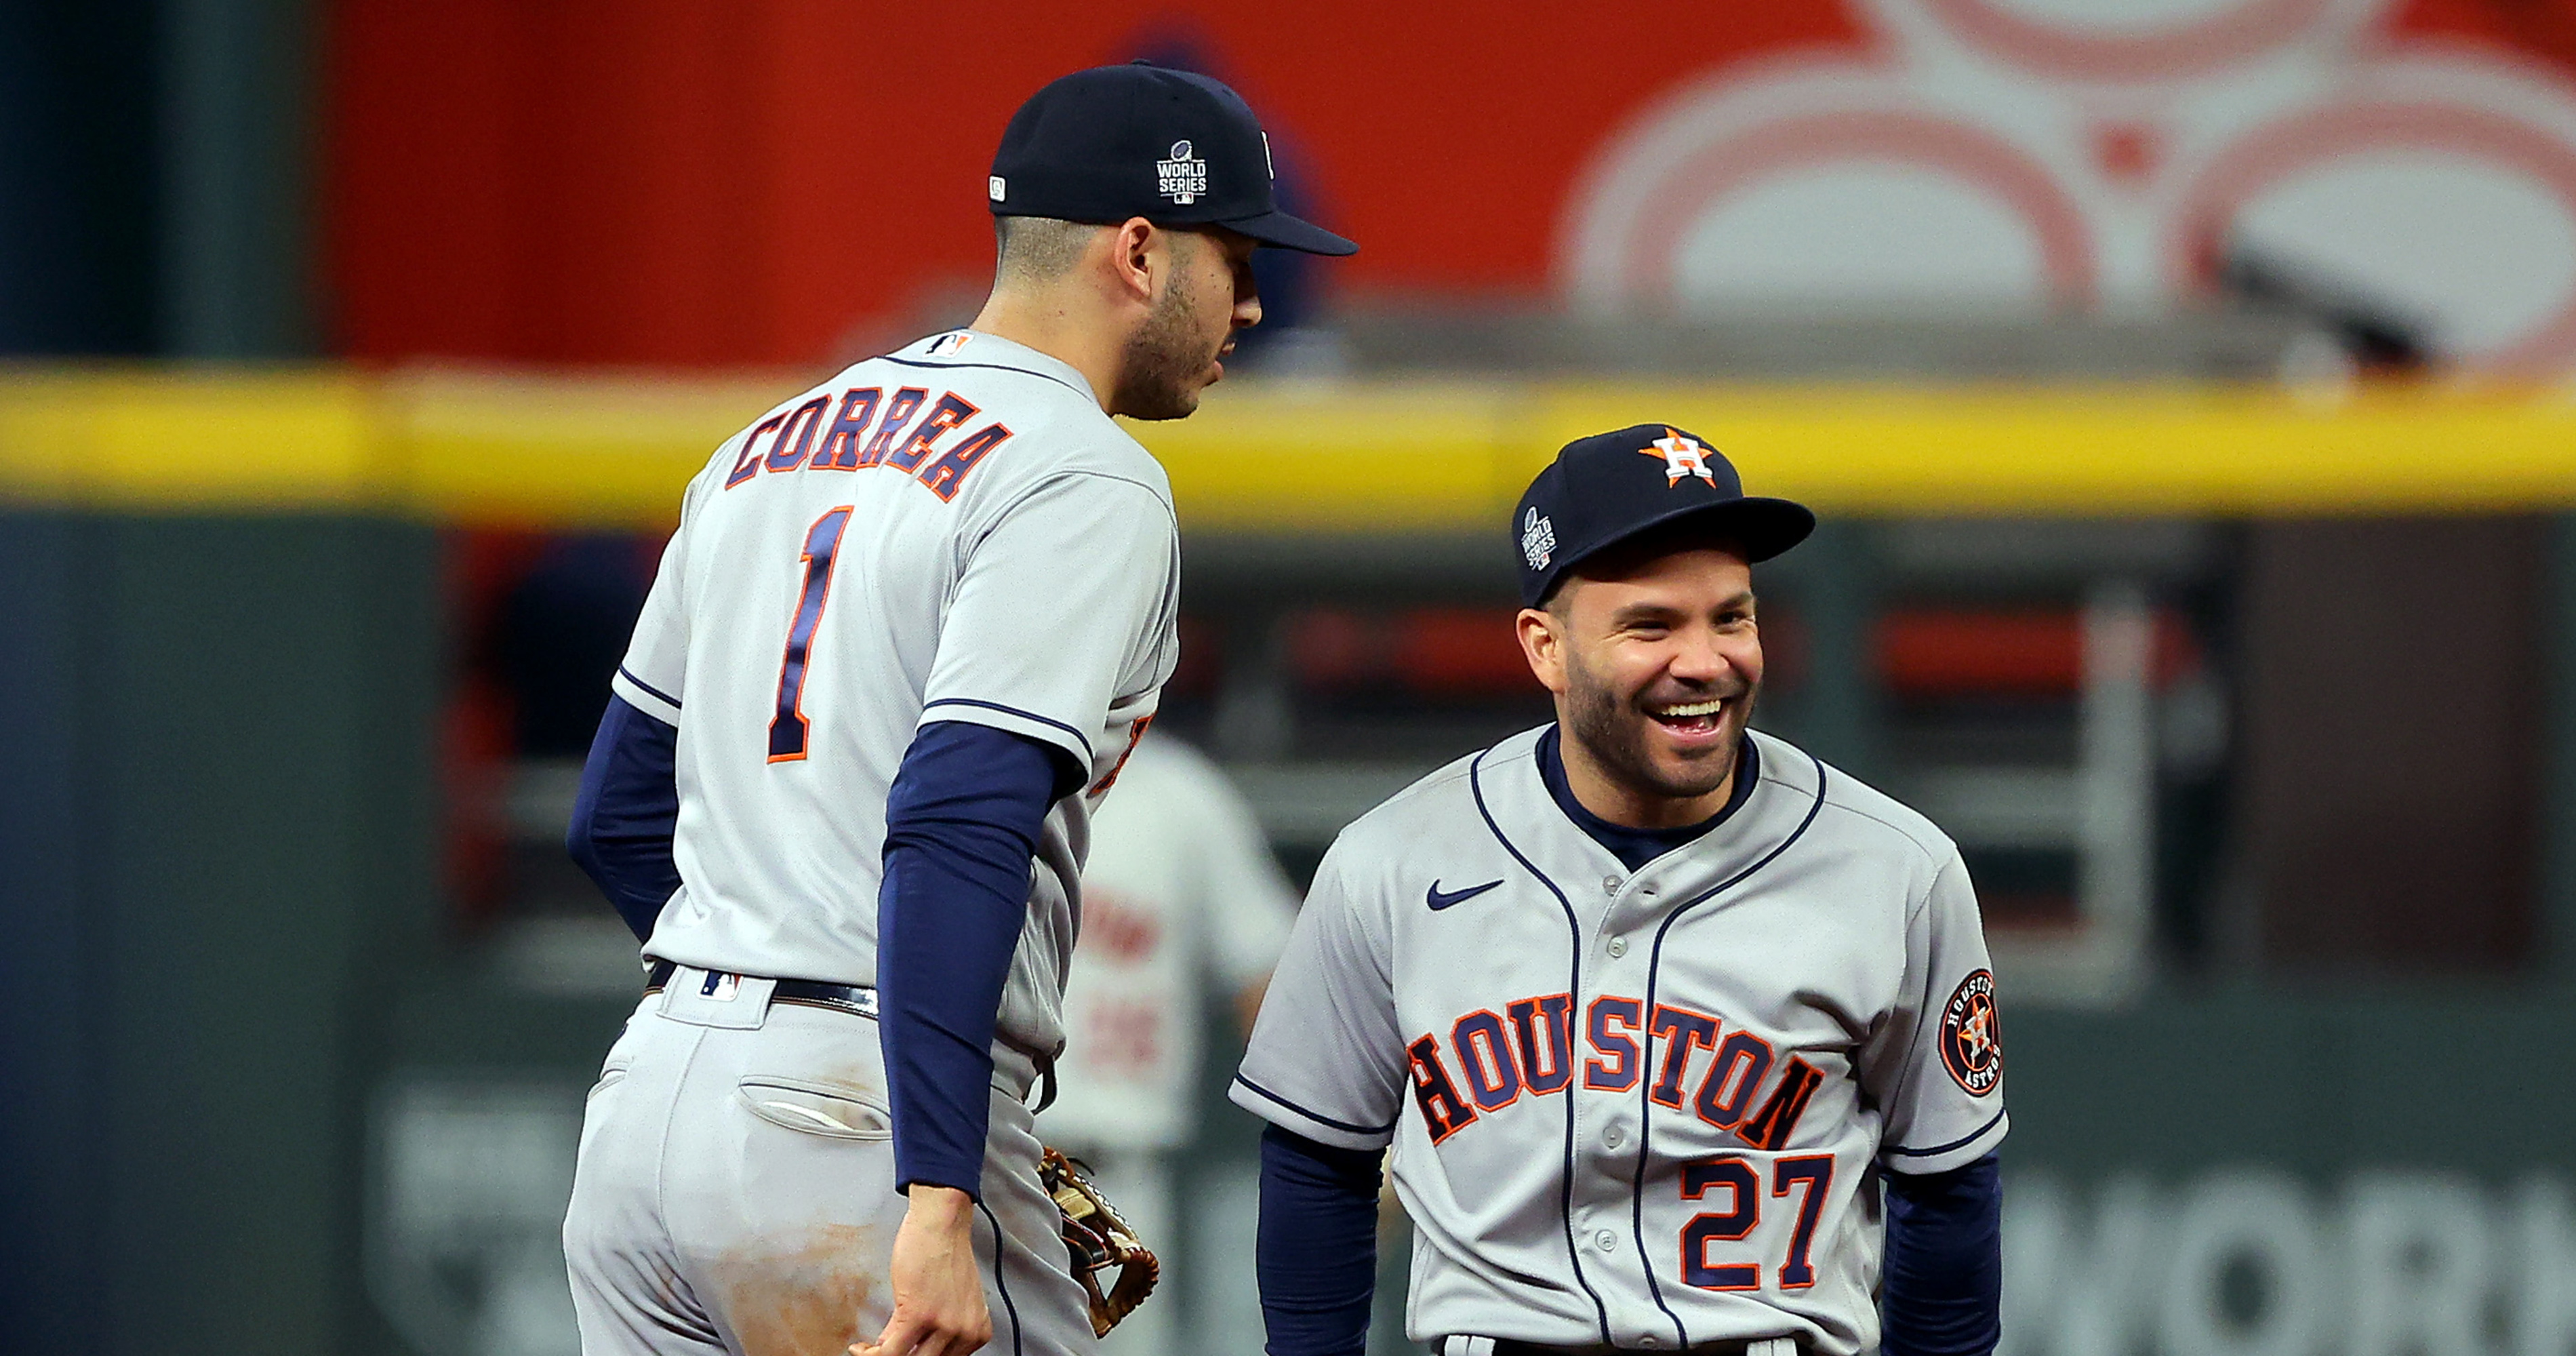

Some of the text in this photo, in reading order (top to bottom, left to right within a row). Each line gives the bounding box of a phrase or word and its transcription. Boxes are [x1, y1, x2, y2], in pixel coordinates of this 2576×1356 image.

[1156, 163, 1206, 178] WORLD
[1159, 178, 1207, 193] SERIES
[725, 386, 1013, 503] CORREA
[1652, 437, 1713, 479] H
[1521, 519, 1552, 554] WORLD
[1526, 532, 1556, 567] SERIES
[767, 505, 854, 763] 1
[1407, 993, 1825, 1151] HOUSTON
[1965, 1044, 2001, 1088] ASTROS
[1680, 1153, 1834, 1291] 27
